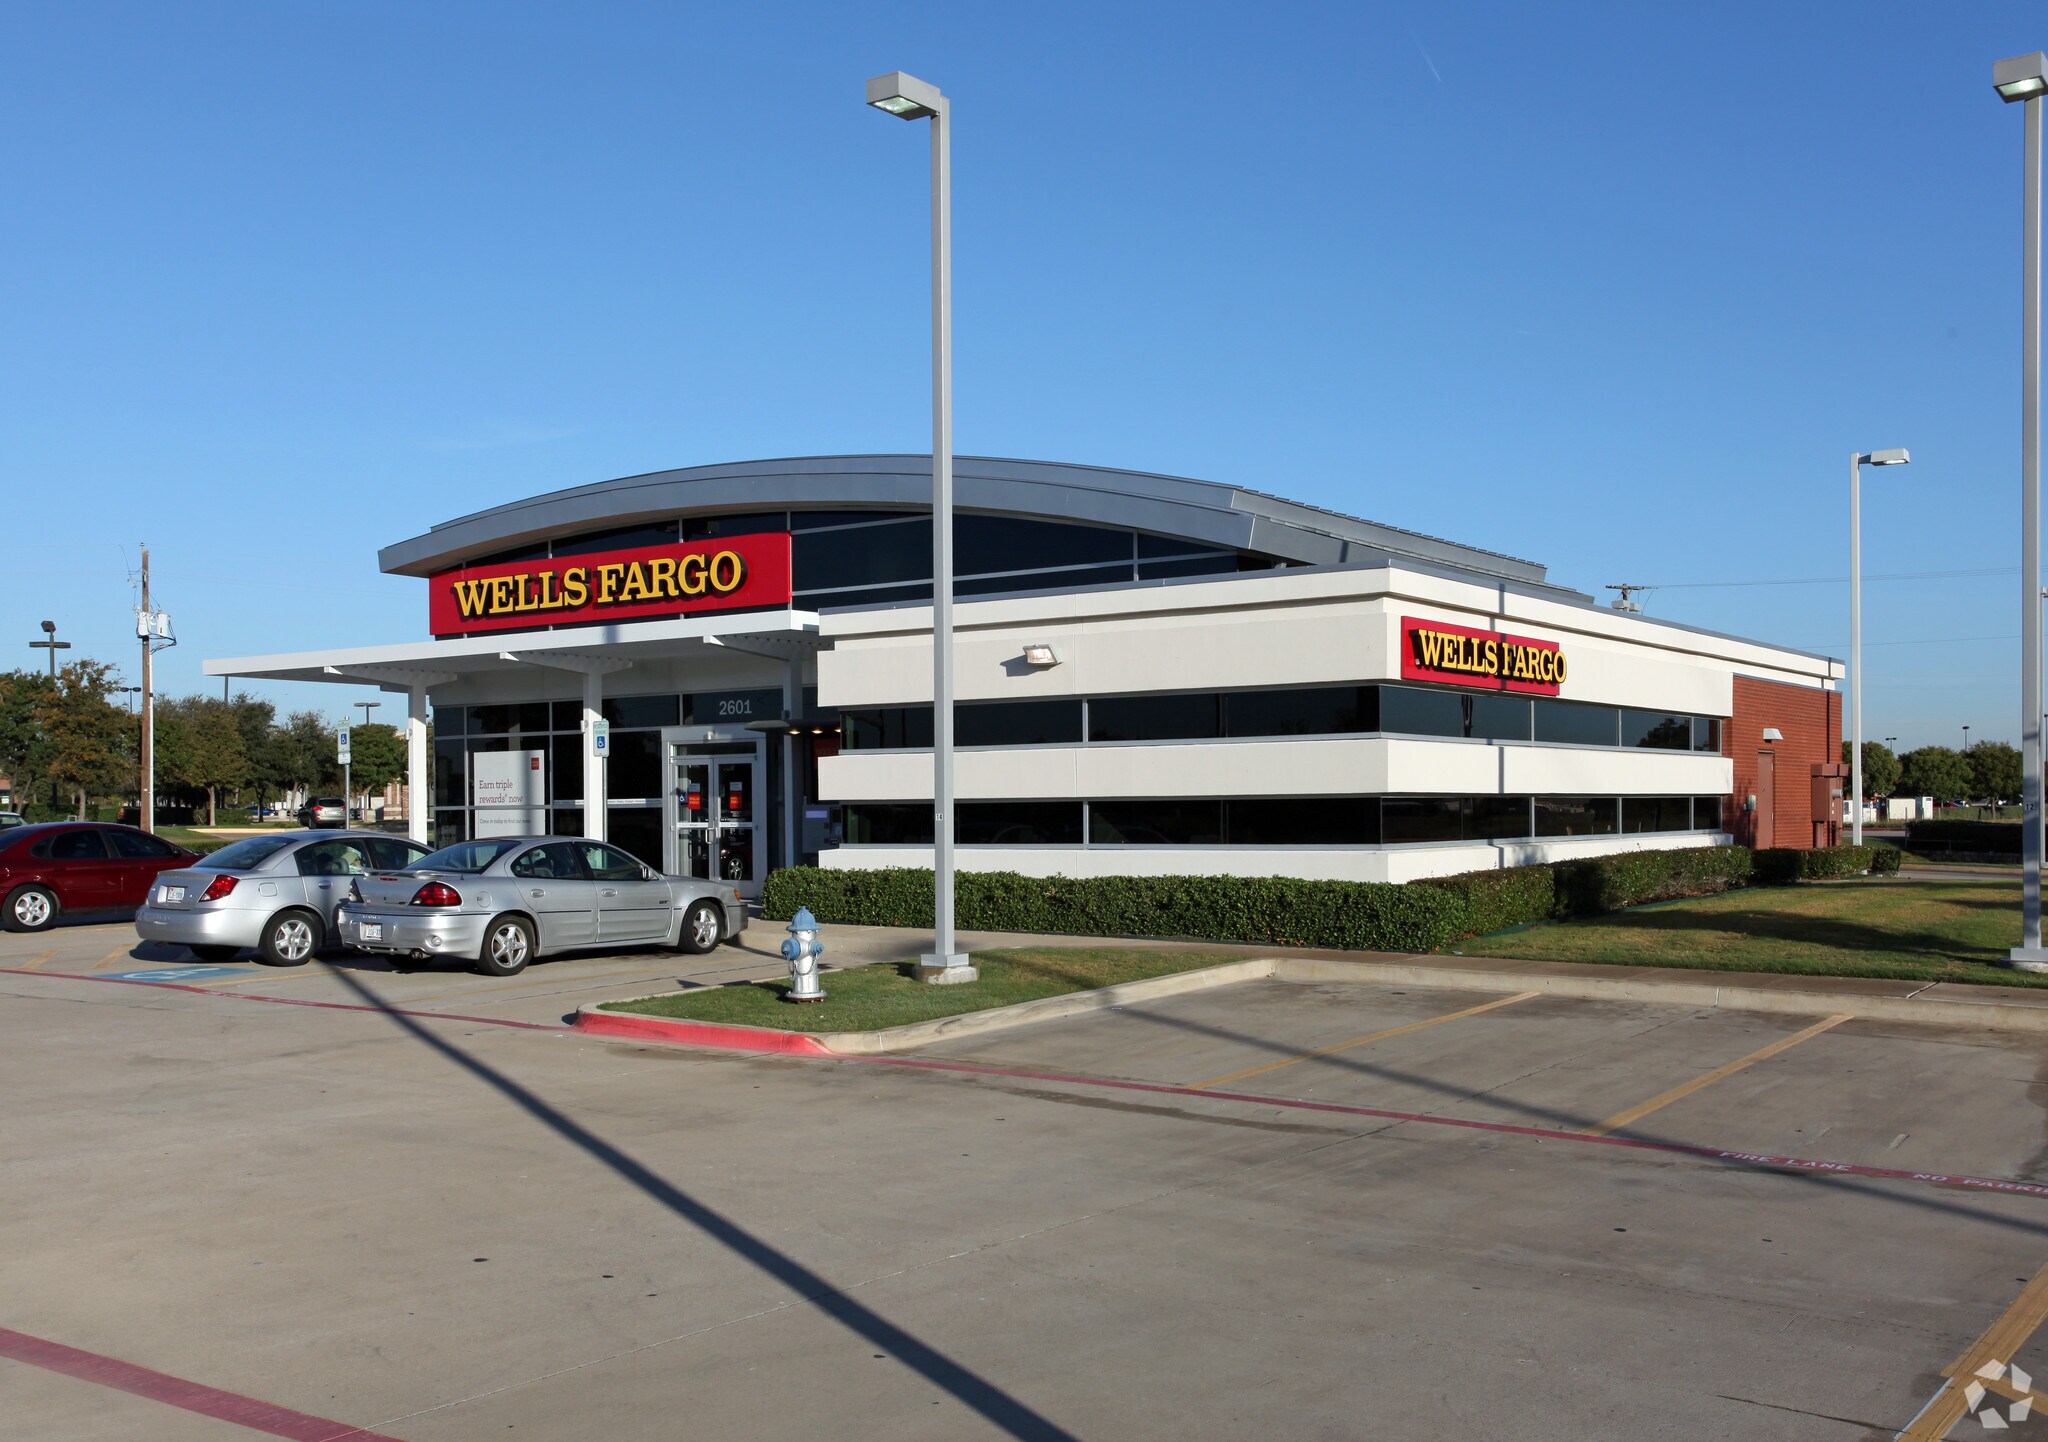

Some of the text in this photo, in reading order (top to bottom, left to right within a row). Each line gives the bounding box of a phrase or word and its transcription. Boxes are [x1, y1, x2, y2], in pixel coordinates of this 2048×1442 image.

[454, 550, 743, 617] WELLS FARGO
[1418, 629, 1568, 684] WELLS FARGO
[719, 699, 752, 715] 2601
[479, 779, 513, 791] Earn triple
[2025, 803, 2034, 811] 12
[1719, 1151, 1852, 1171] FIRE LANE
[1913, 1173, 2048, 1193] NO PARKI
